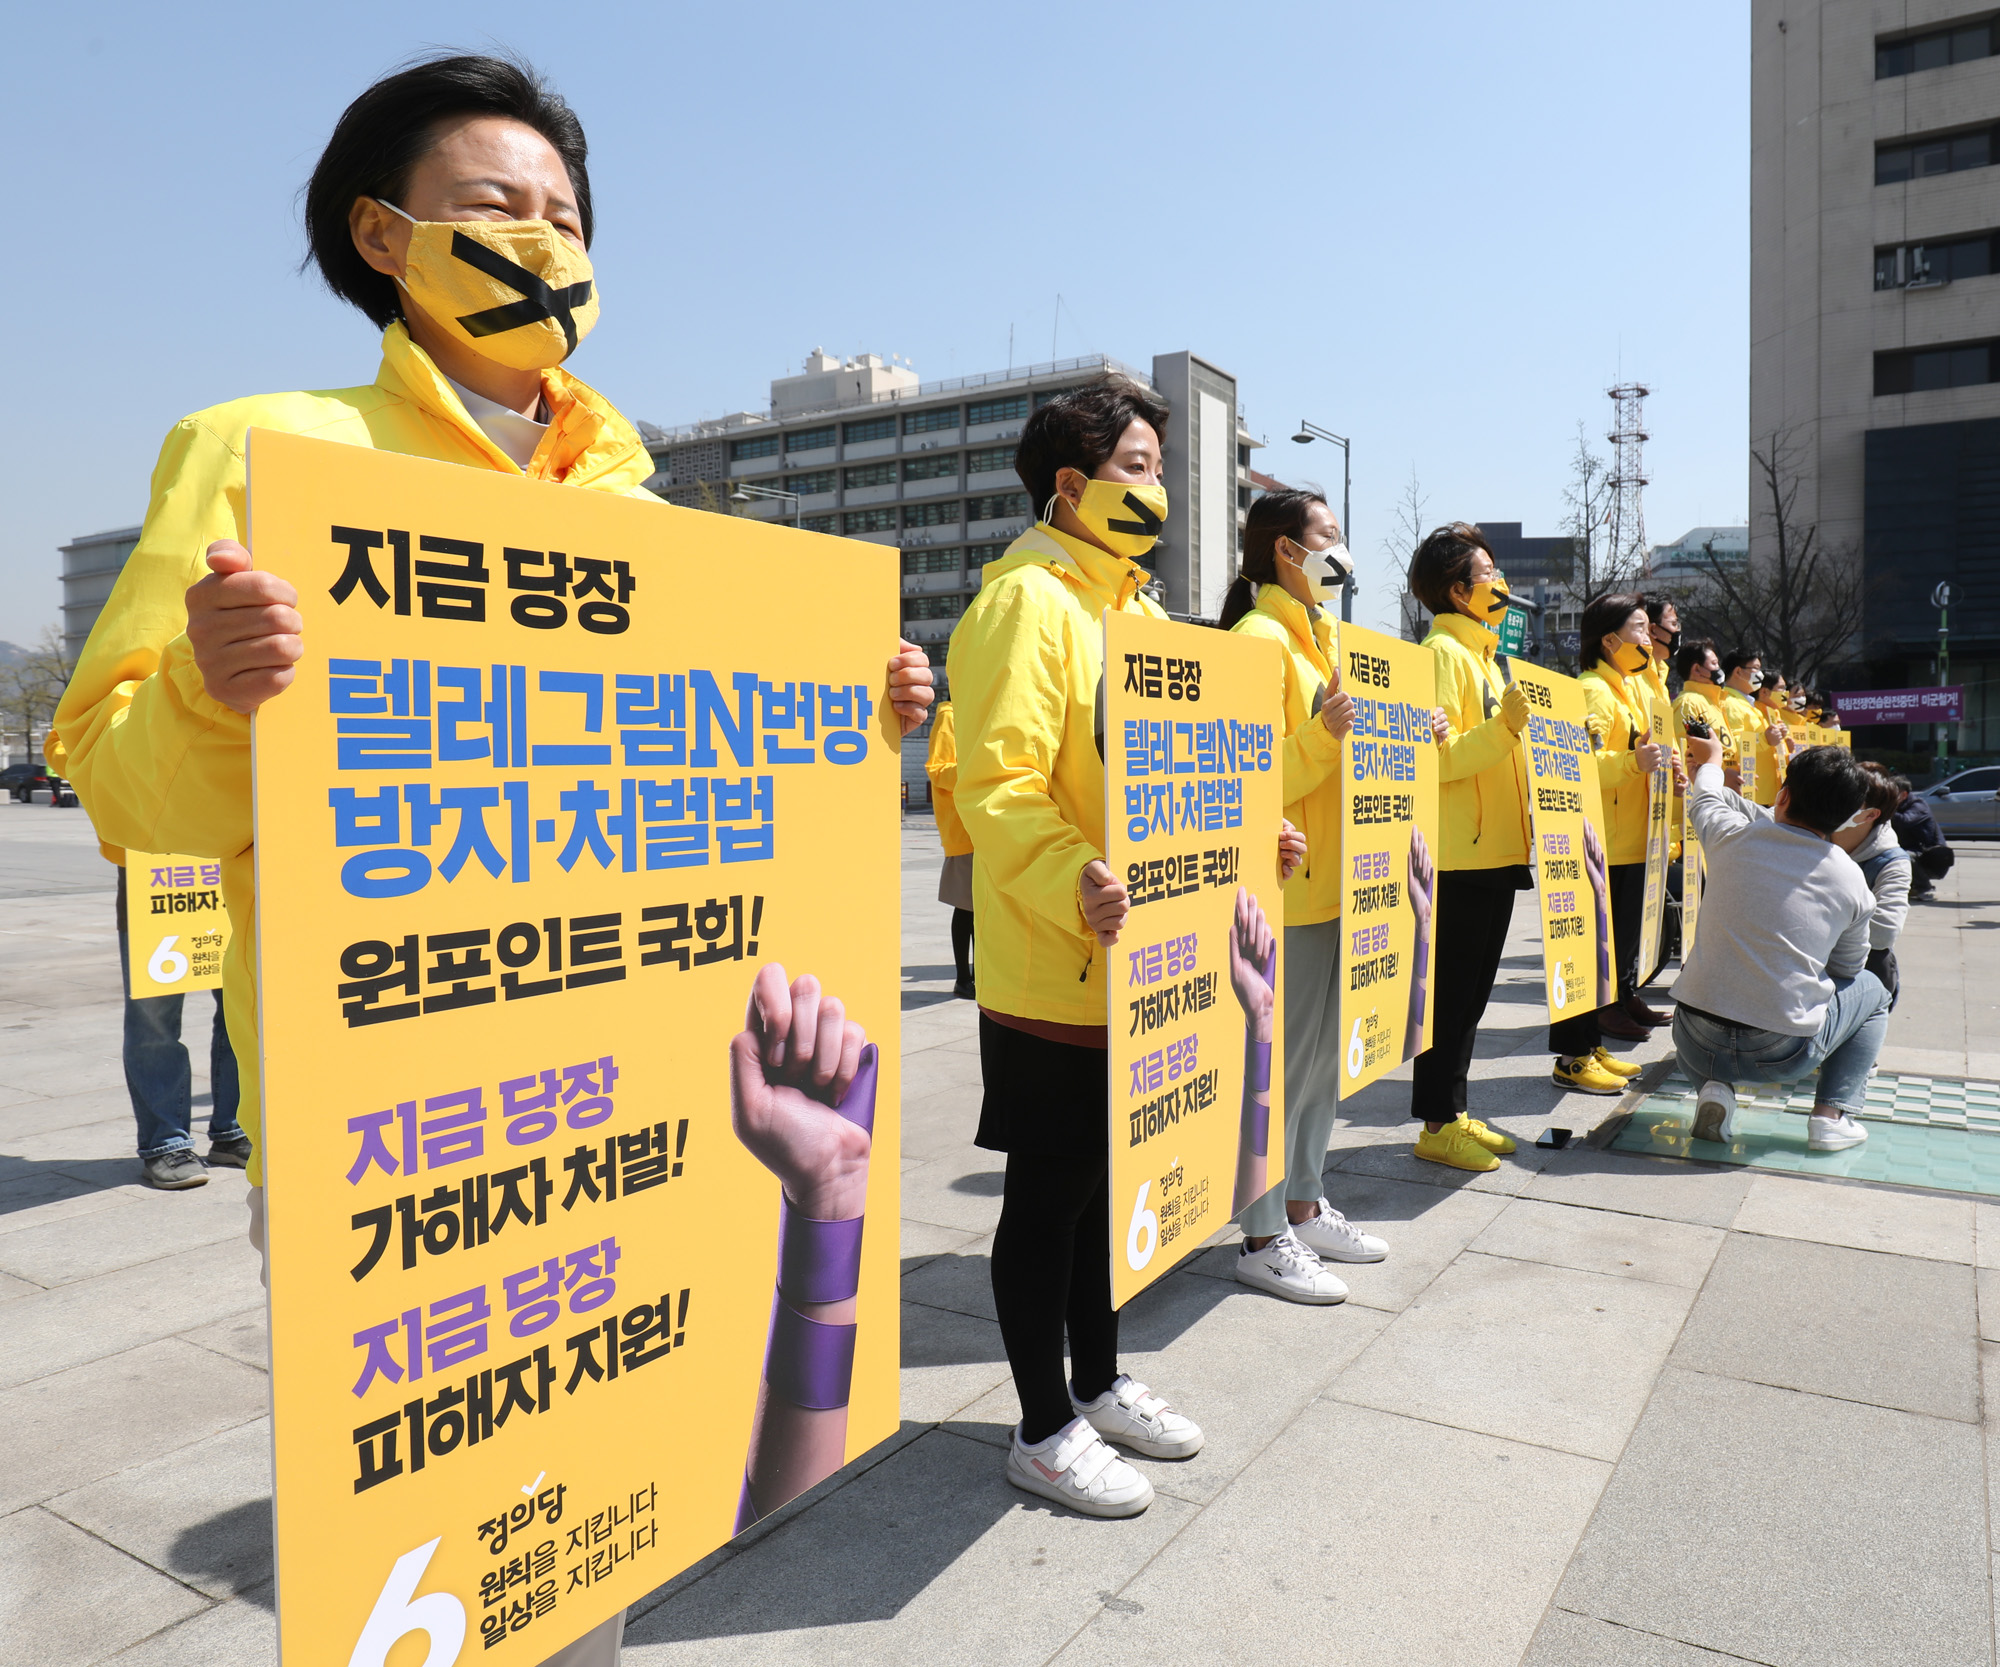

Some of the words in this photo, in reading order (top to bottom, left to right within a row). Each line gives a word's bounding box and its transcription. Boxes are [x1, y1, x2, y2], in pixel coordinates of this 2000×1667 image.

[329, 525, 489, 622] 지금
[503, 546, 635, 635] 당장
[1124, 653, 1163, 698] 지금
[1167, 659, 1202, 701] 당장
[1350, 652, 1370, 684] 지금
[1371, 657, 1390, 689] 당장
[1519, 680, 1537, 704] 지금
[1536, 685, 1552, 709] 당장
[328, 658, 873, 770] 텔레그램N번방
[1351, 697, 1432, 744] 텔레그램N번방
[1124, 719, 1274, 776] 텔레그램N번방
[1124, 778, 1243, 842] 방지·처벌법
[1353, 794, 1391, 825] 원포인트
[1393, 794, 1414, 822] 국회!
[1538, 787, 1567, 812] 원포인트
[328, 775, 775, 899] 방지·처벌법
[1542, 834, 1557, 855] 지금
[1557, 834, 1570, 855] 당장
[150, 866, 195, 888] 지금
[199, 864, 221, 886] 당
[1127, 853, 1200, 908] 원포인트
[1203, 846, 1240, 889] 국회!
[1352, 854, 1372, 881] 지금
[1373, 851, 1390, 879] 당장
[1545, 860, 1566, 881] 가해자
[1566, 859, 1580, 880] 처벌!
[150, 890, 219, 915] 피해자
[1352, 886, 1380, 915] 가해자
[1381, 882, 1401, 909] 처벌!
[1547, 892, 1562, 914] 지금
[1562, 891, 1575, 912] 당장
[191, 934, 224, 949] 정의당
[1351, 927, 1370, 957] 지금
[1372, 923, 1389, 953] 당장
[1549, 918, 1570, 940] 피해자
[1570, 916, 1585, 937] 지원!
[147, 935, 189, 984] 6
[191, 951, 221, 964] 원칙을
[191, 963, 221, 976] 일상을
[338, 912, 627, 1028] 원포인트
[638, 895, 764, 972] 국회!
[1128, 943, 1163, 988] 지금
[1166, 932, 1198, 978] 당장
[1351, 957, 1378, 991] 피해자
[1379, 952, 1399, 981] 지원!
[1129, 983, 1180, 1038] 가해자
[1182, 972, 1218, 1015] 처벌!
[1553, 961, 1566, 1010] 6
[1129, 1043, 1163, 1099] 지금
[1167, 1033, 1199, 1078] 당장
[1347, 1016, 1364, 1079] 6
[346, 1087, 487, 1186] 지금
[500, 1055, 618, 1147] 당장
[1129, 1092, 1181, 1149] 피해자
[1183, 1069, 1218, 1117] 지원!
[350, 1156, 553, 1283] 가해자
[561, 1119, 689, 1209] 처벌!
[1160, 1166, 1184, 1197] 정의당
[1160, 1195, 1182, 1227] 원칙을
[1182, 1176, 1209, 1207] 지킵니다
[1126, 1179, 1158, 1272] 6
[1160, 1218, 1181, 1248] 일상을
[1182, 1197, 1209, 1228] 지킵니다
[351, 1284, 491, 1399] 지금
[503, 1237, 621, 1338] 당장
[353, 1344, 557, 1495] 피해자
[565, 1288, 690, 1395] 지원!
[478, 1483, 567, 1555] 정의당
[478, 1539, 558, 1609] 원칙을
[566, 1482, 658, 1557] 지킵니다
[347, 1535, 467, 1667] 6
[479, 1579, 557, 1650] 일상을
[567, 1525, 659, 1590] 지킵니다
